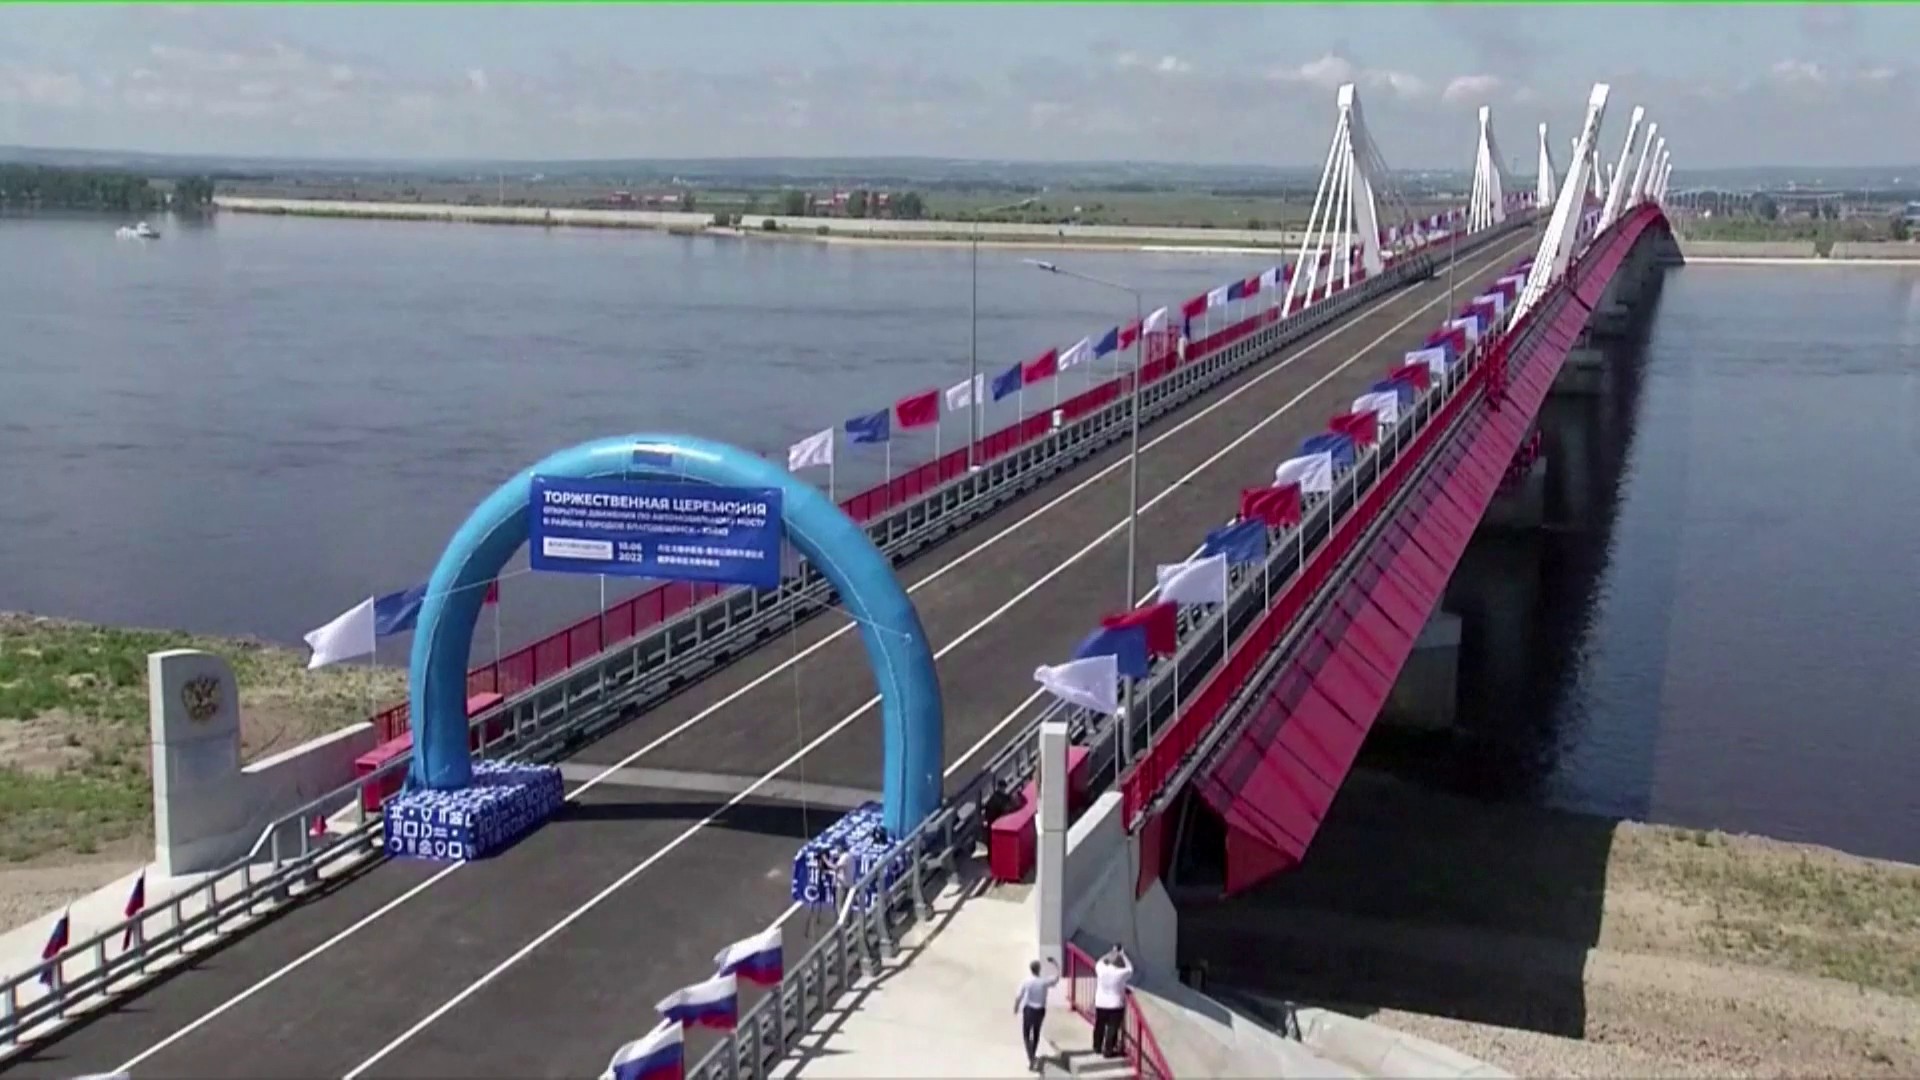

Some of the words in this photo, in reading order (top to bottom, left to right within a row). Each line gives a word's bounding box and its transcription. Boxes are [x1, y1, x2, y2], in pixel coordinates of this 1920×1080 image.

[543, 491, 670, 511] ТОРЖЕСТВЕННАЯ
[673, 498, 766, 516] ЦЕРЕМОНИЯ
[737, 518, 766, 528] МОСТУ
[618, 552, 643, 563] 2022
